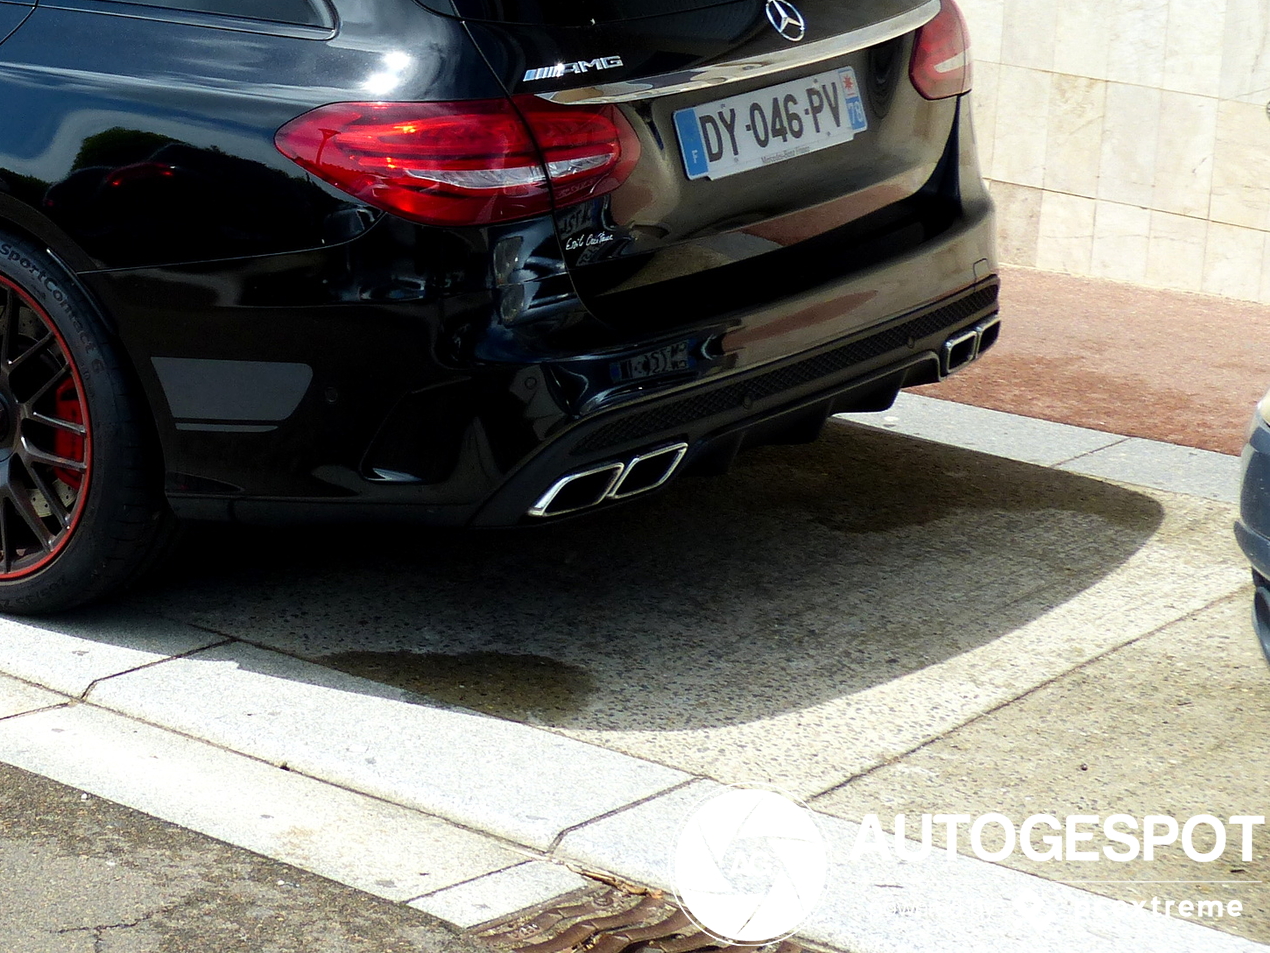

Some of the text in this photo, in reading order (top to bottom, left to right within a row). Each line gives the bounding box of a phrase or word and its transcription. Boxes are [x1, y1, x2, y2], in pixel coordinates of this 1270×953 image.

[560, 55, 624, 76] AMG
[699, 81, 841, 163] DY-046-PV
[847, 100, 864, 125] 78
[691, 149, 698, 164] F
